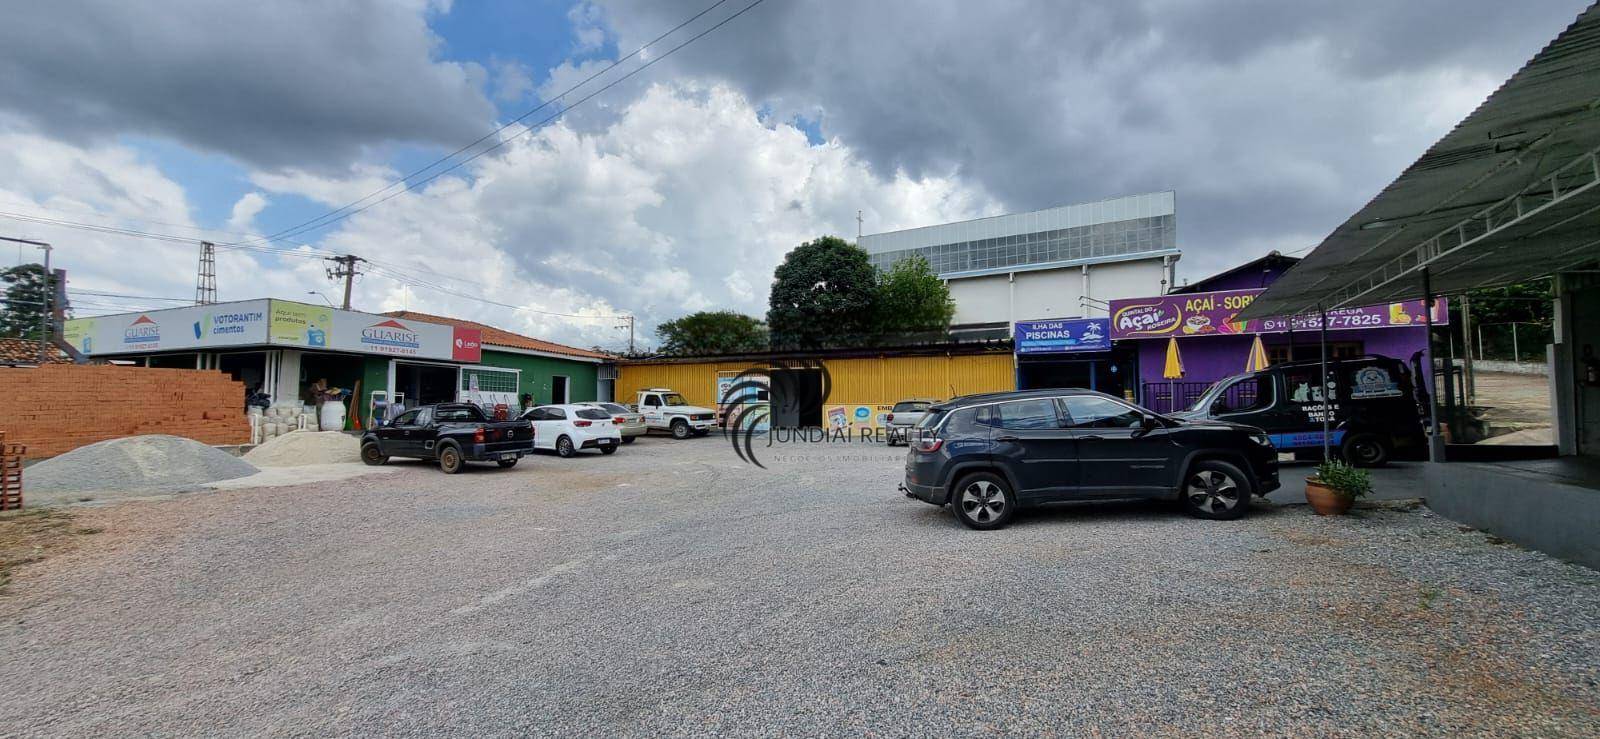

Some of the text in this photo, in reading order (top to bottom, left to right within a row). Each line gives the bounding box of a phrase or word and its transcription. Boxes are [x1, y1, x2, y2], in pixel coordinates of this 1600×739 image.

[1185, 295, 1215, 314] AÇAÍ
[214, 312, 263, 323] VOTORANTIM
[125, 325, 160, 338] GUARISE
[213, 325, 245, 335] cimentos
[361, 328, 420, 343] GUARISE
[1026, 330, 1070, 340] PISCINAS
